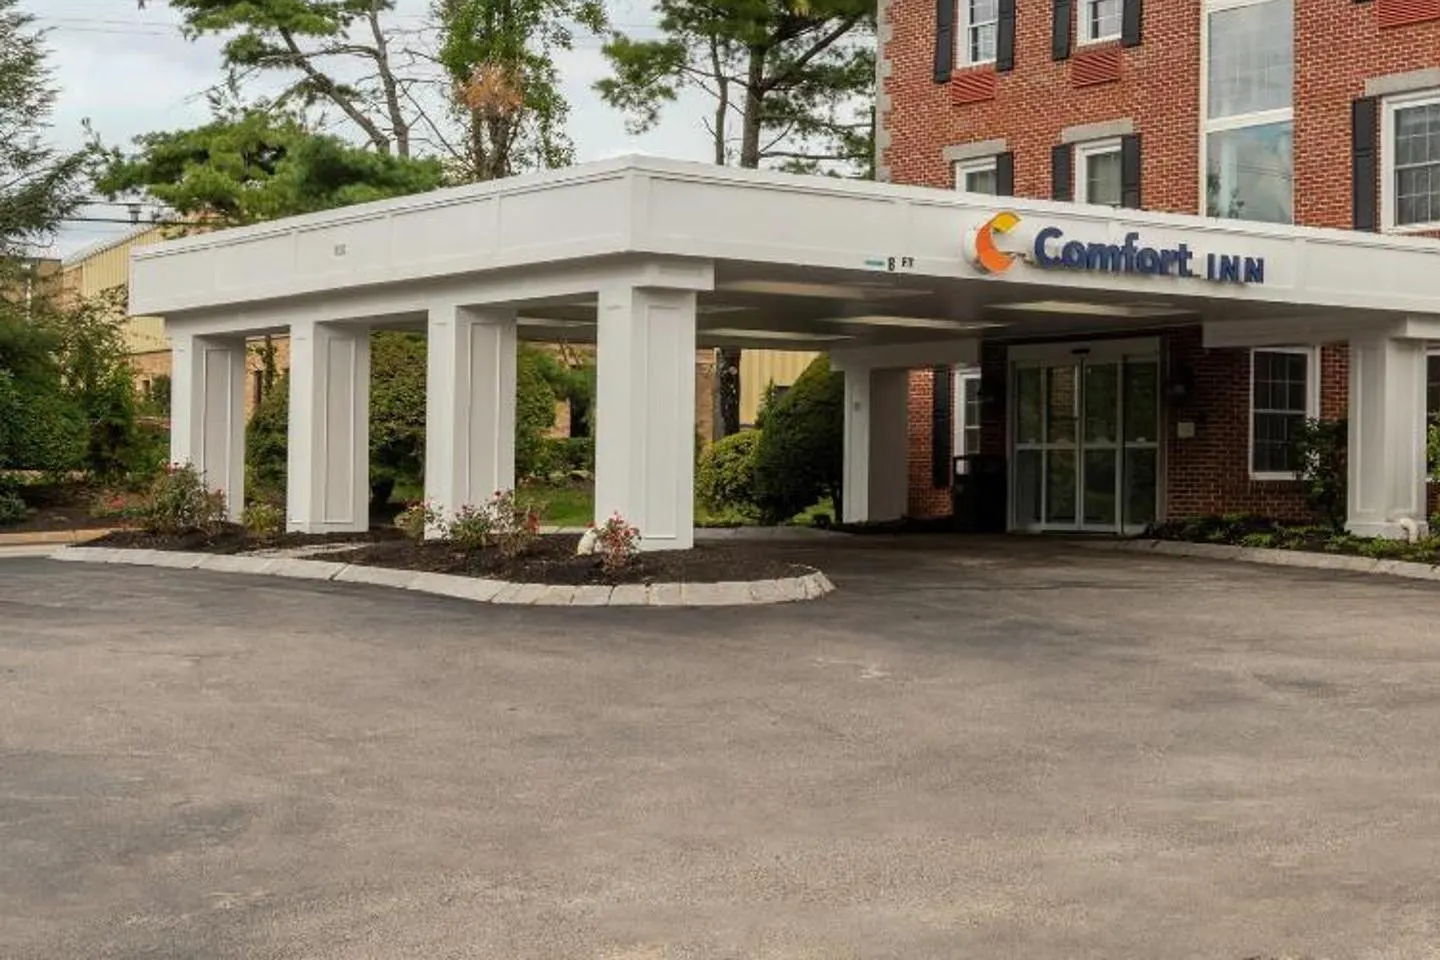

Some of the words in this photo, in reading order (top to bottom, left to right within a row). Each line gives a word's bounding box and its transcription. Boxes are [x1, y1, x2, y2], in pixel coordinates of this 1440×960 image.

[902, 256, 914, 268] FT
[1034, 227, 1193, 277] Comfort
[1207, 253, 1264, 284] INN
